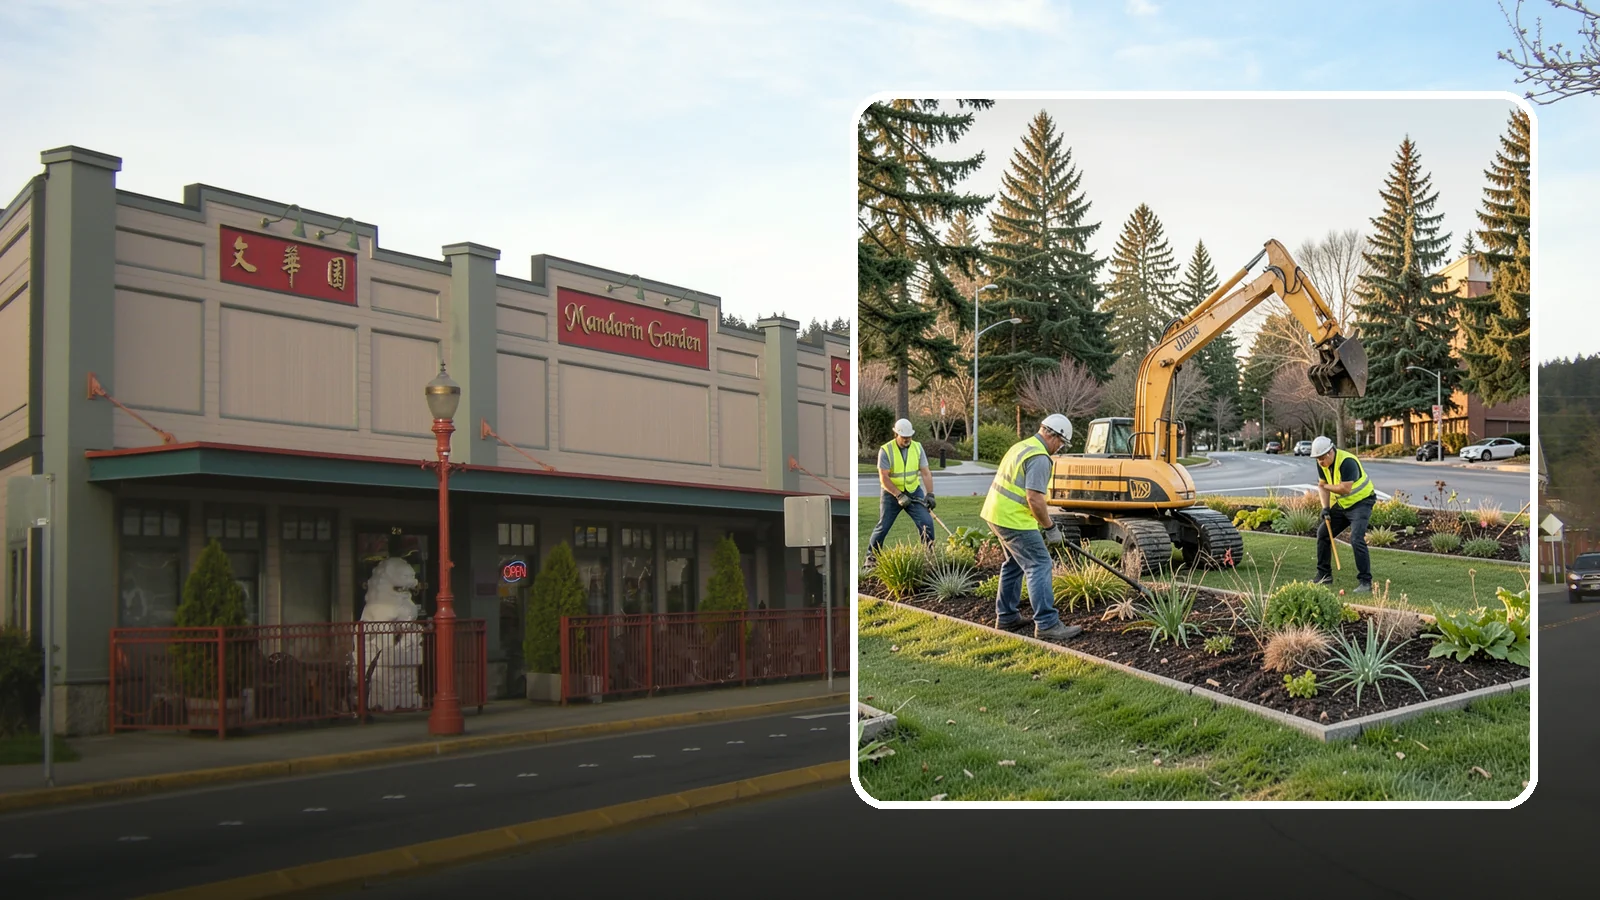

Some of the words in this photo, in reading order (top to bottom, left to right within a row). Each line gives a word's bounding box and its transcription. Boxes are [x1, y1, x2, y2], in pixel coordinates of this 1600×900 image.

[230, 236, 346, 291] 文華園
[565, 302, 644, 341] Mandarin
[648, 320, 701, 352] Garden
[503, 565, 527, 578] OPEN
